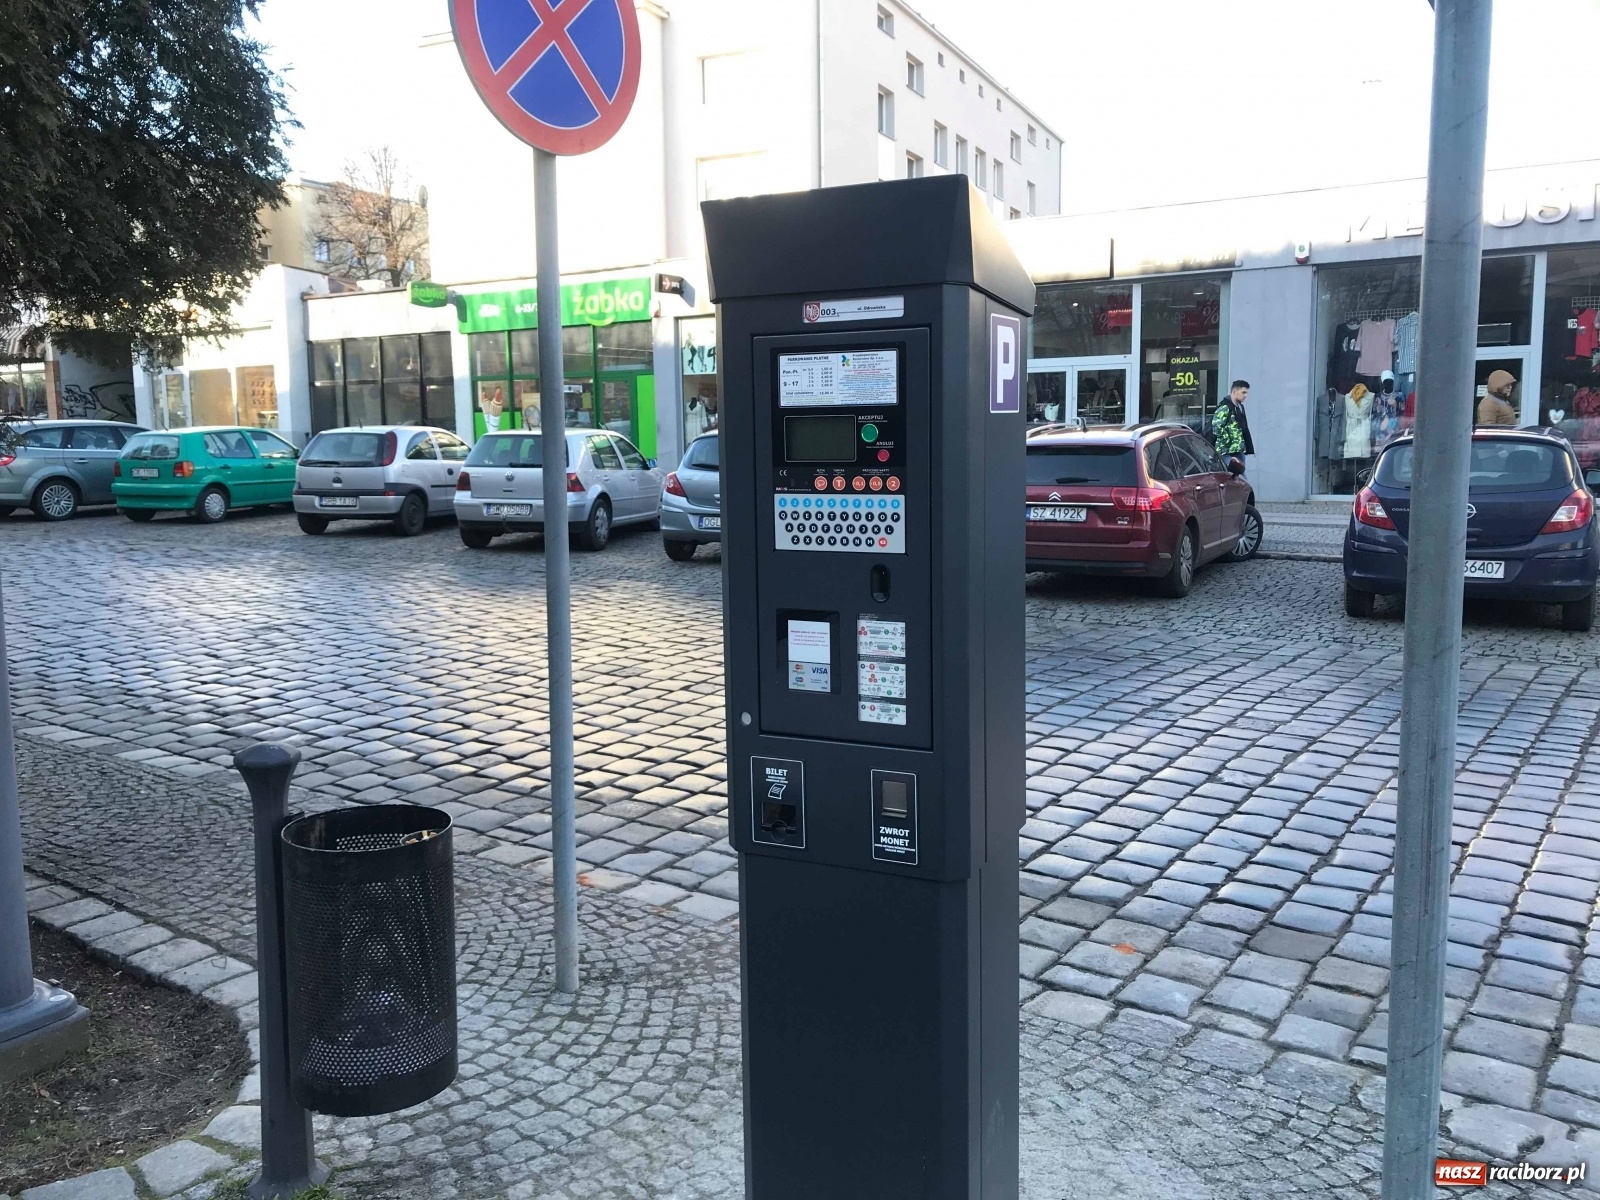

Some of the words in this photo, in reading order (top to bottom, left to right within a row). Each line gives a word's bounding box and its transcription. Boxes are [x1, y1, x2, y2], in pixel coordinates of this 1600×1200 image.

[413, 285, 446, 300] żabka
[572, 287, 644, 316] żabka
[820, 308, 836, 316] 003
[996, 325, 1015, 404] P
[1032, 507, 1046, 518] SZ
[1050, 508, 1084, 519] 4192K
[766, 767, 788, 777] BILET
[879, 826, 910, 837] ZWROT
[880, 836, 910, 847] MONET
